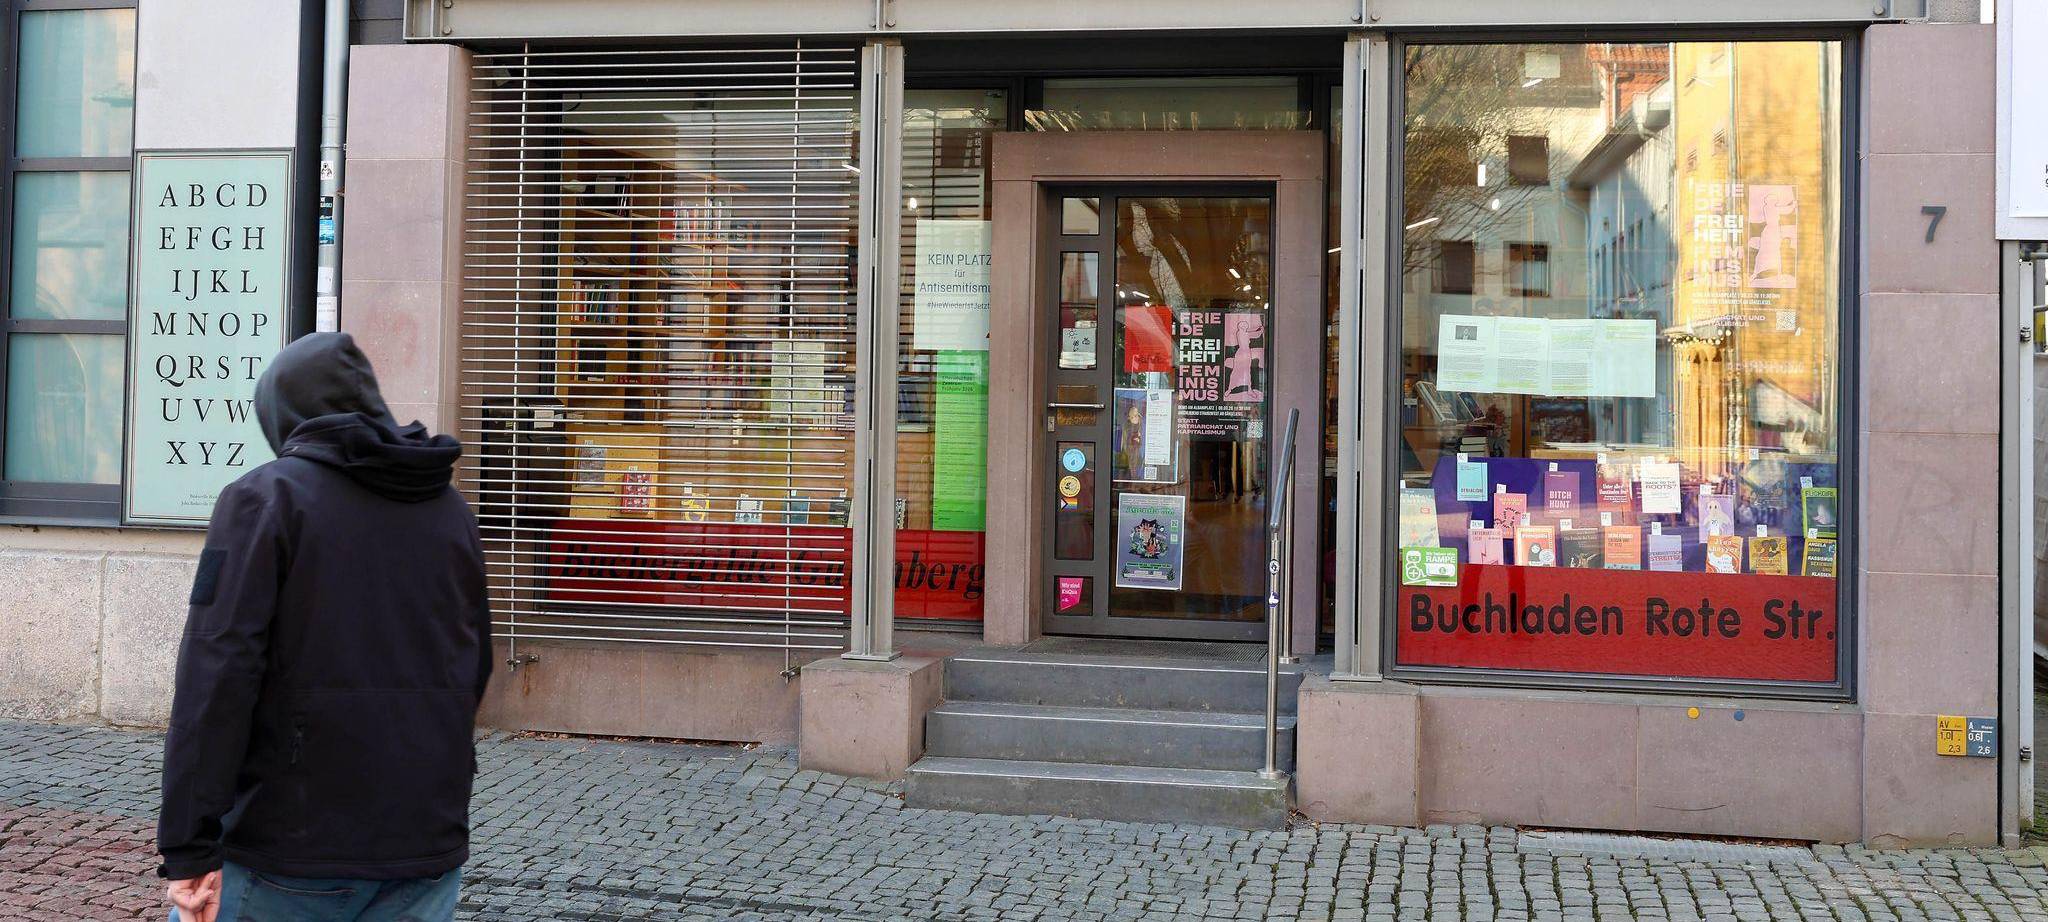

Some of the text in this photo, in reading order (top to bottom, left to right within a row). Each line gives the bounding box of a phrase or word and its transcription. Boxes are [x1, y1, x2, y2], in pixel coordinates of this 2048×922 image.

[1695, 214, 1744, 228] FREI
[1921, 205, 1947, 243] 7
[1695, 228, 1743, 242] HEIT
[928, 254, 992, 265] KEIN PLATZ
[954, 269, 966, 278] für
[1180, 312, 1221, 324] FRIE
[1180, 324, 1203, 336] DE
[1180, 339, 1221, 350] FREI
[1179, 351, 1220, 362] HEIT
[1179, 365, 1220, 376] FEM
[1179, 377, 1218, 389] INIS
[1179, 389, 1218, 401] MUS
[1549, 491, 1572, 499] BITCH
[1549, 500, 1571, 508] HUNT
[1410, 592, 1836, 641] Buchladen Rote Str.
[1969, 722, 1974, 730] A
[1968, 734, 1981, 742] 0,6
[1949, 745, 1961, 753] 2,3
[1978, 746, 1990, 755] 2,6
